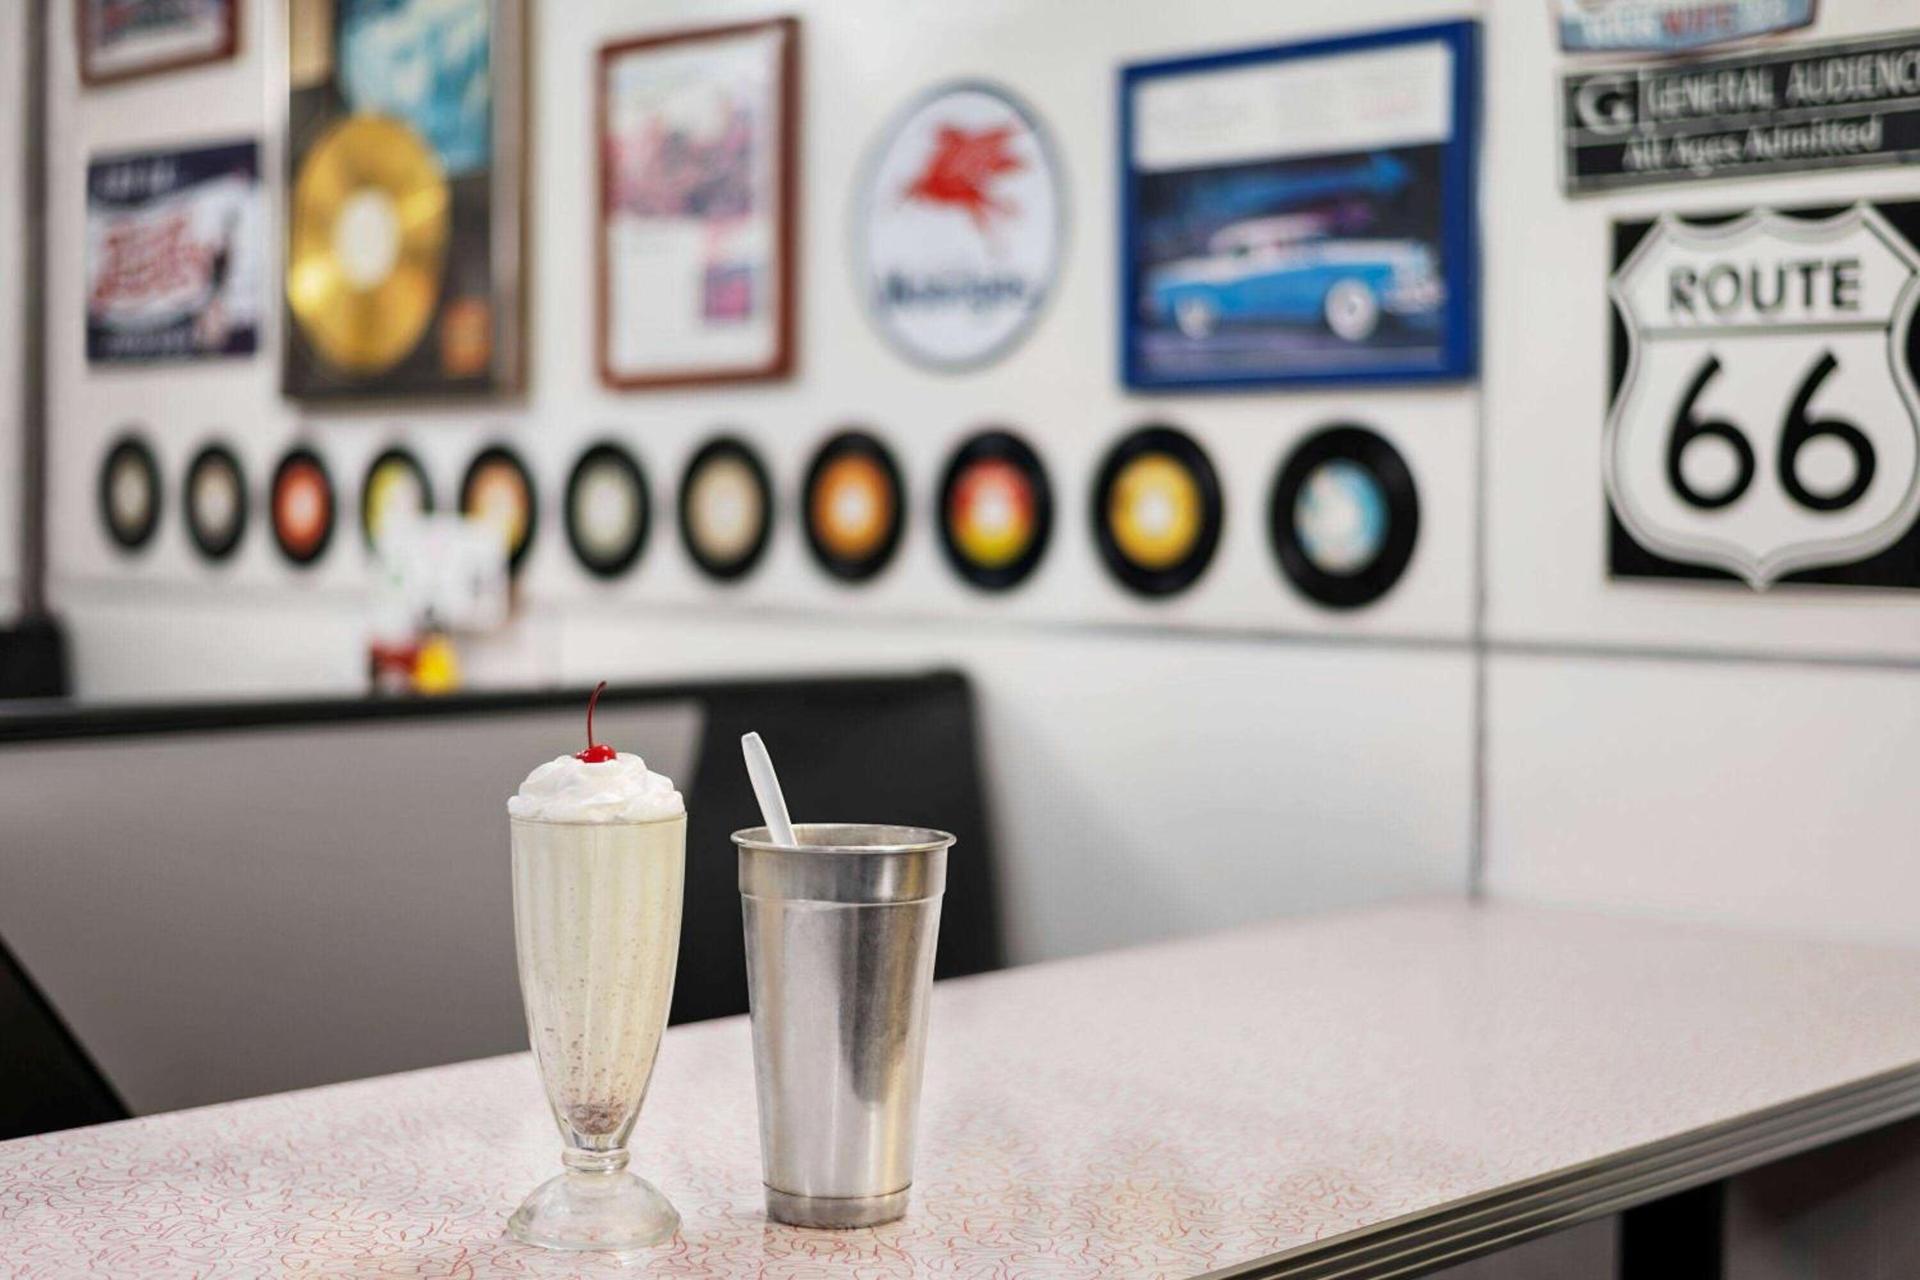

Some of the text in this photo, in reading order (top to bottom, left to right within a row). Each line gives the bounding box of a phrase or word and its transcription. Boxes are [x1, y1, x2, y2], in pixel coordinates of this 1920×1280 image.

[1577, 75, 1635, 135] G
[1648, 66, 1774, 119] GENERAL
[1670, 131, 1741, 177] Ages
[1744, 113, 1883, 159] Admitted
[1668, 257, 1862, 316] ROUTE
[1667, 346, 1876, 512] 66
